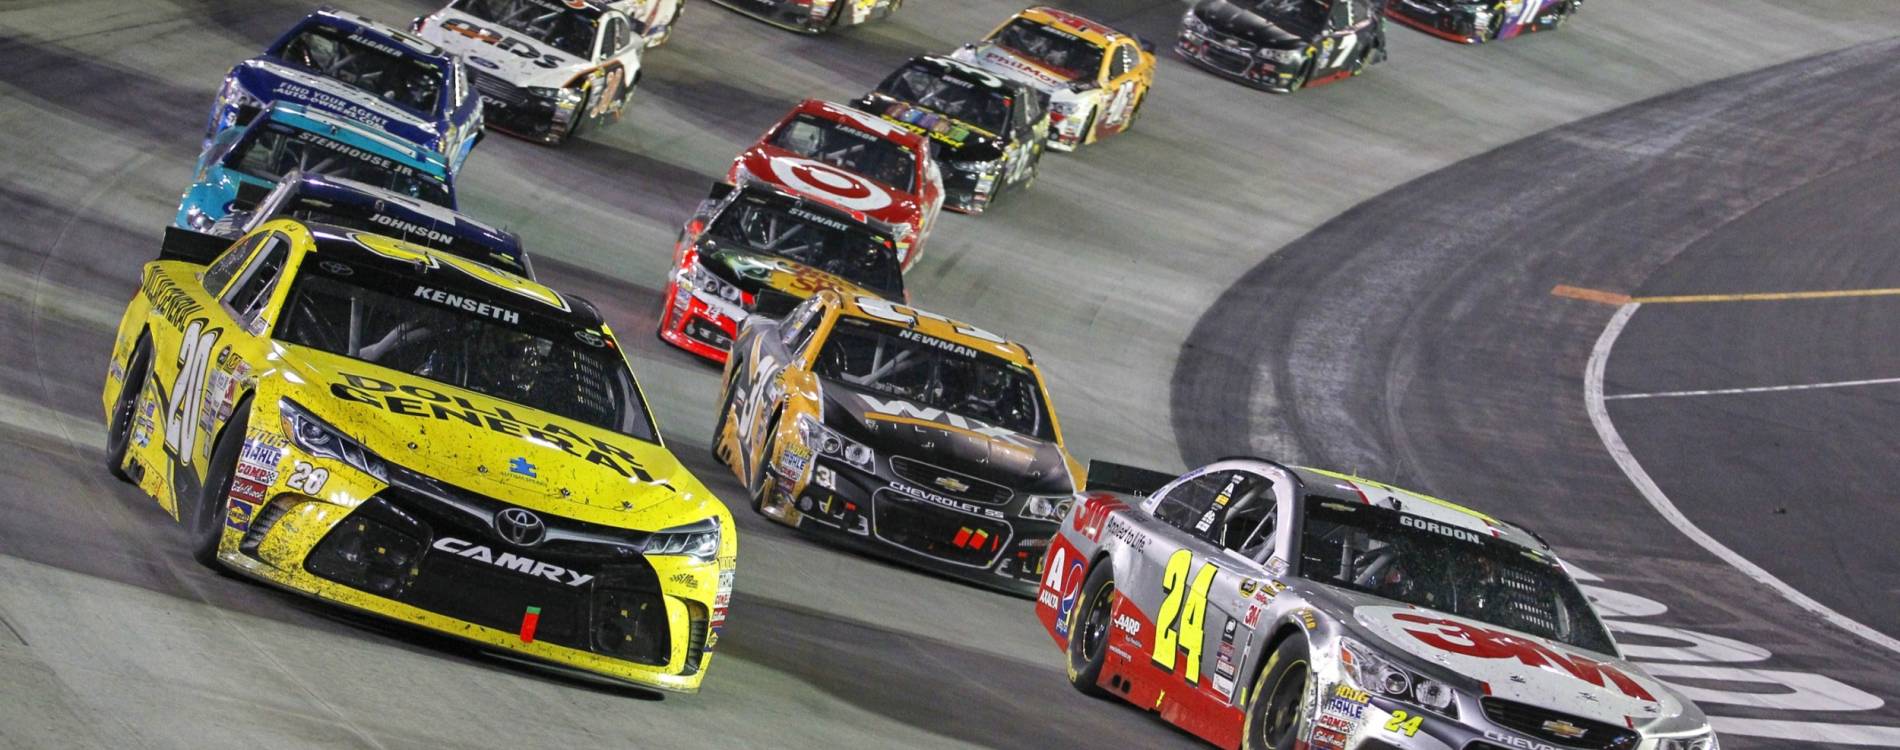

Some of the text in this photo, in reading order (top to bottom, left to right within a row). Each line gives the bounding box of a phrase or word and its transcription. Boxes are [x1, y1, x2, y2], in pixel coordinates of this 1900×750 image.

[347, 33, 403, 58] ALLGAIER
[280, 81, 388, 126] FIND YOUR AGENT
[835, 124, 878, 142] LARSON
[299, 131, 413, 176] STENHOUSE JR
[368, 213, 454, 244] JOHNSON
[788, 207, 849, 232] STEWART
[413, 285, 519, 324] KENSETH
[899, 329, 977, 358] NEWMAN
[163, 318, 224, 467] 20
[338, 371, 644, 467] DOLLAR
[856, 393, 1029, 448] WIX
[330, 382, 677, 493] GENERAL
[241, 443, 281, 467] MAHLE
[238, 463, 268, 478] COMP
[285, 461, 329, 495] 20
[816, 465, 836, 490] 31
[889, 481, 1004, 519] CHEVROLET SS
[1400, 515, 1480, 545] GORDON
[432, 537, 595, 587] CAMRY
[1039, 589, 1059, 610] AXALTA
[1114, 614, 1141, 636] AARP
[1152, 548, 1220, 688] 24
[1392, 612, 1658, 701] 3M
[1321, 714, 1348, 731] COMP
[1324, 699, 1363, 719] MAHLE
[1384, 709, 1424, 737] 24
